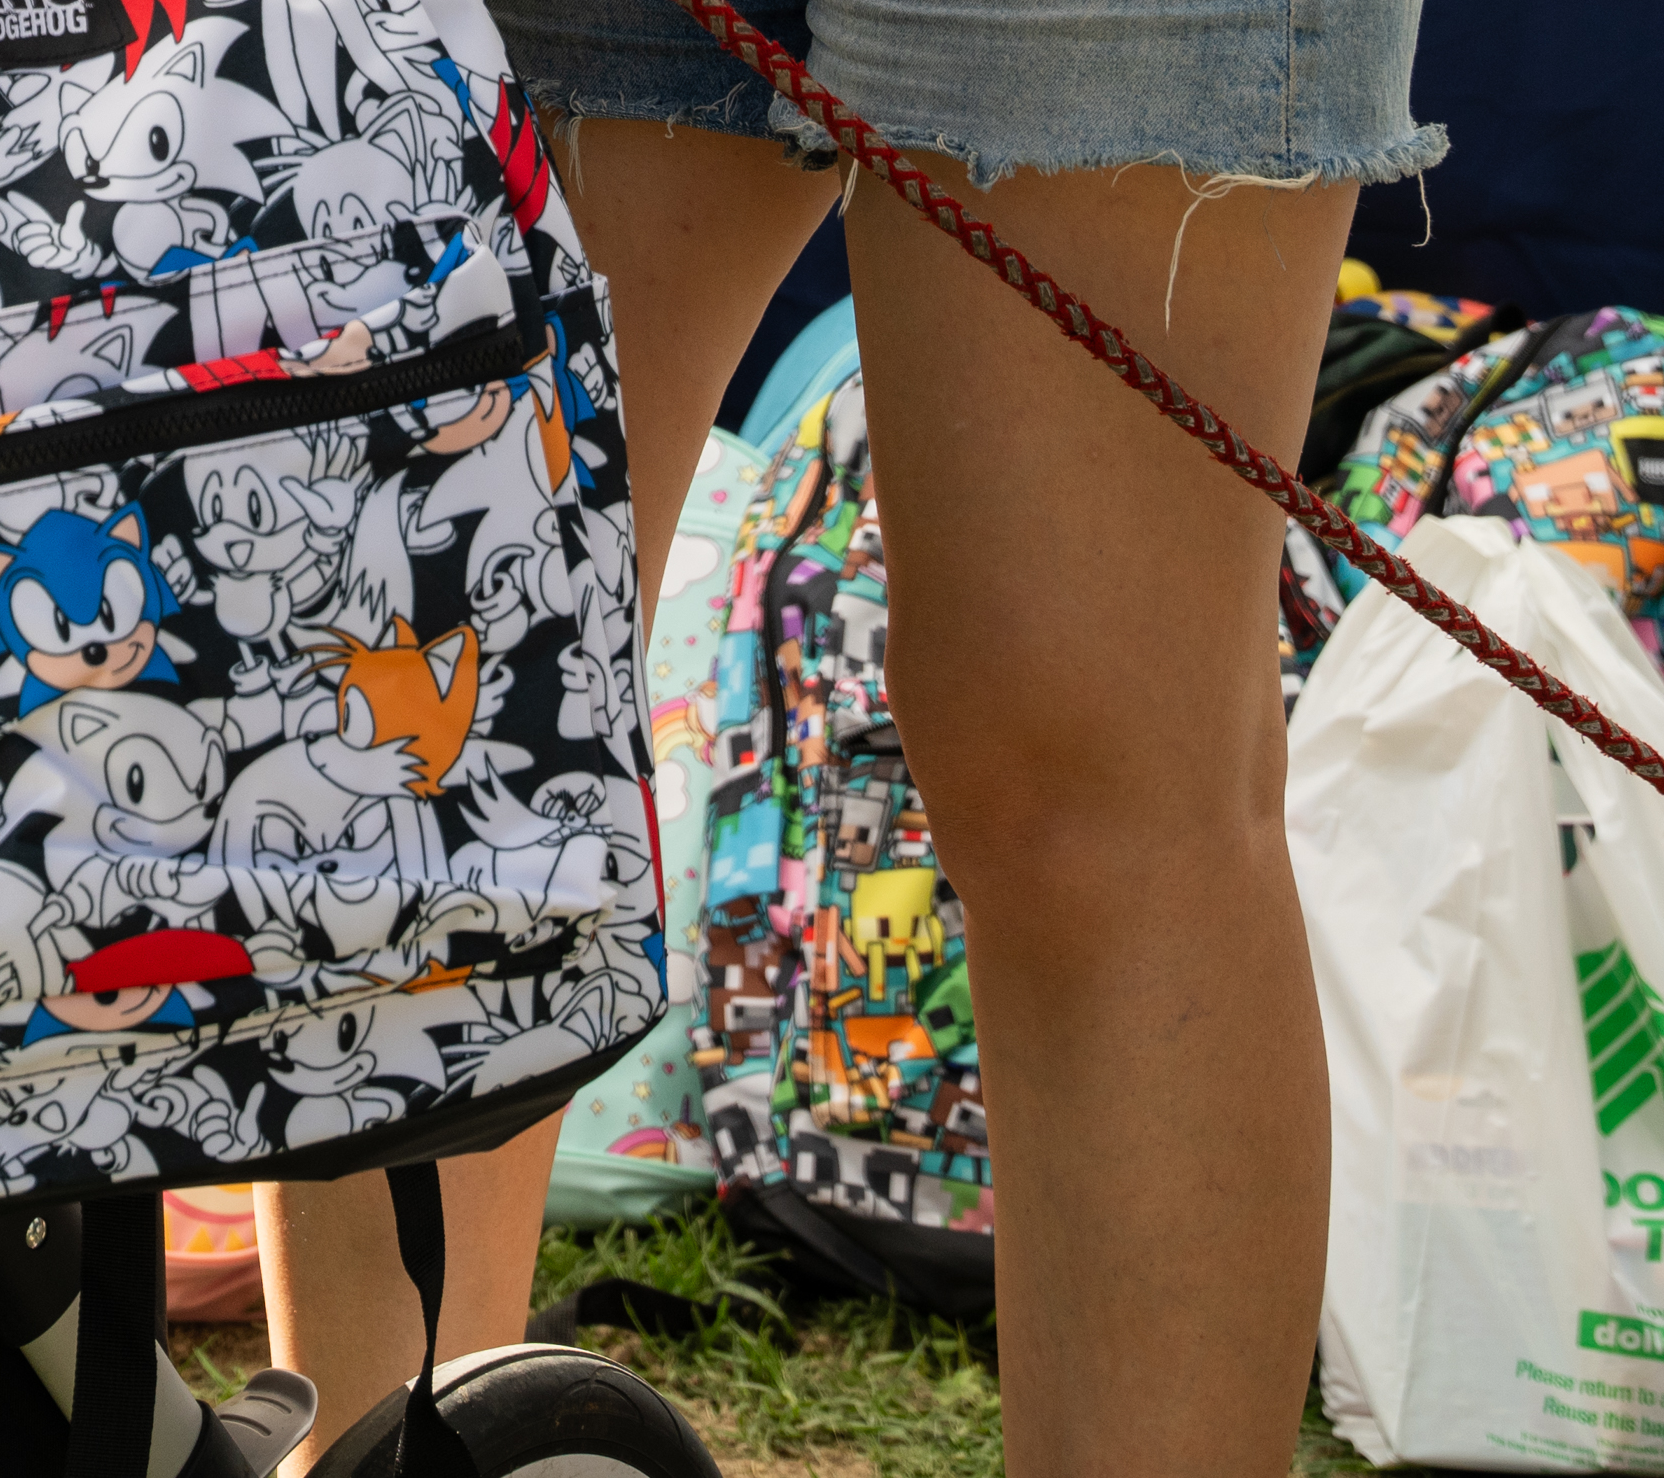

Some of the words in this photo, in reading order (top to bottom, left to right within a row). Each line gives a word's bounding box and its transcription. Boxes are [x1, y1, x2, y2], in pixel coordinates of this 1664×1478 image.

[1515, 1358, 1575, 1392] Please
[1578, 1380, 1633, 1403] return
[1637, 1386, 1656, 1407] to
[1542, 1394, 1599, 1428] Reuse
[1602, 1409, 1637, 1434] this
